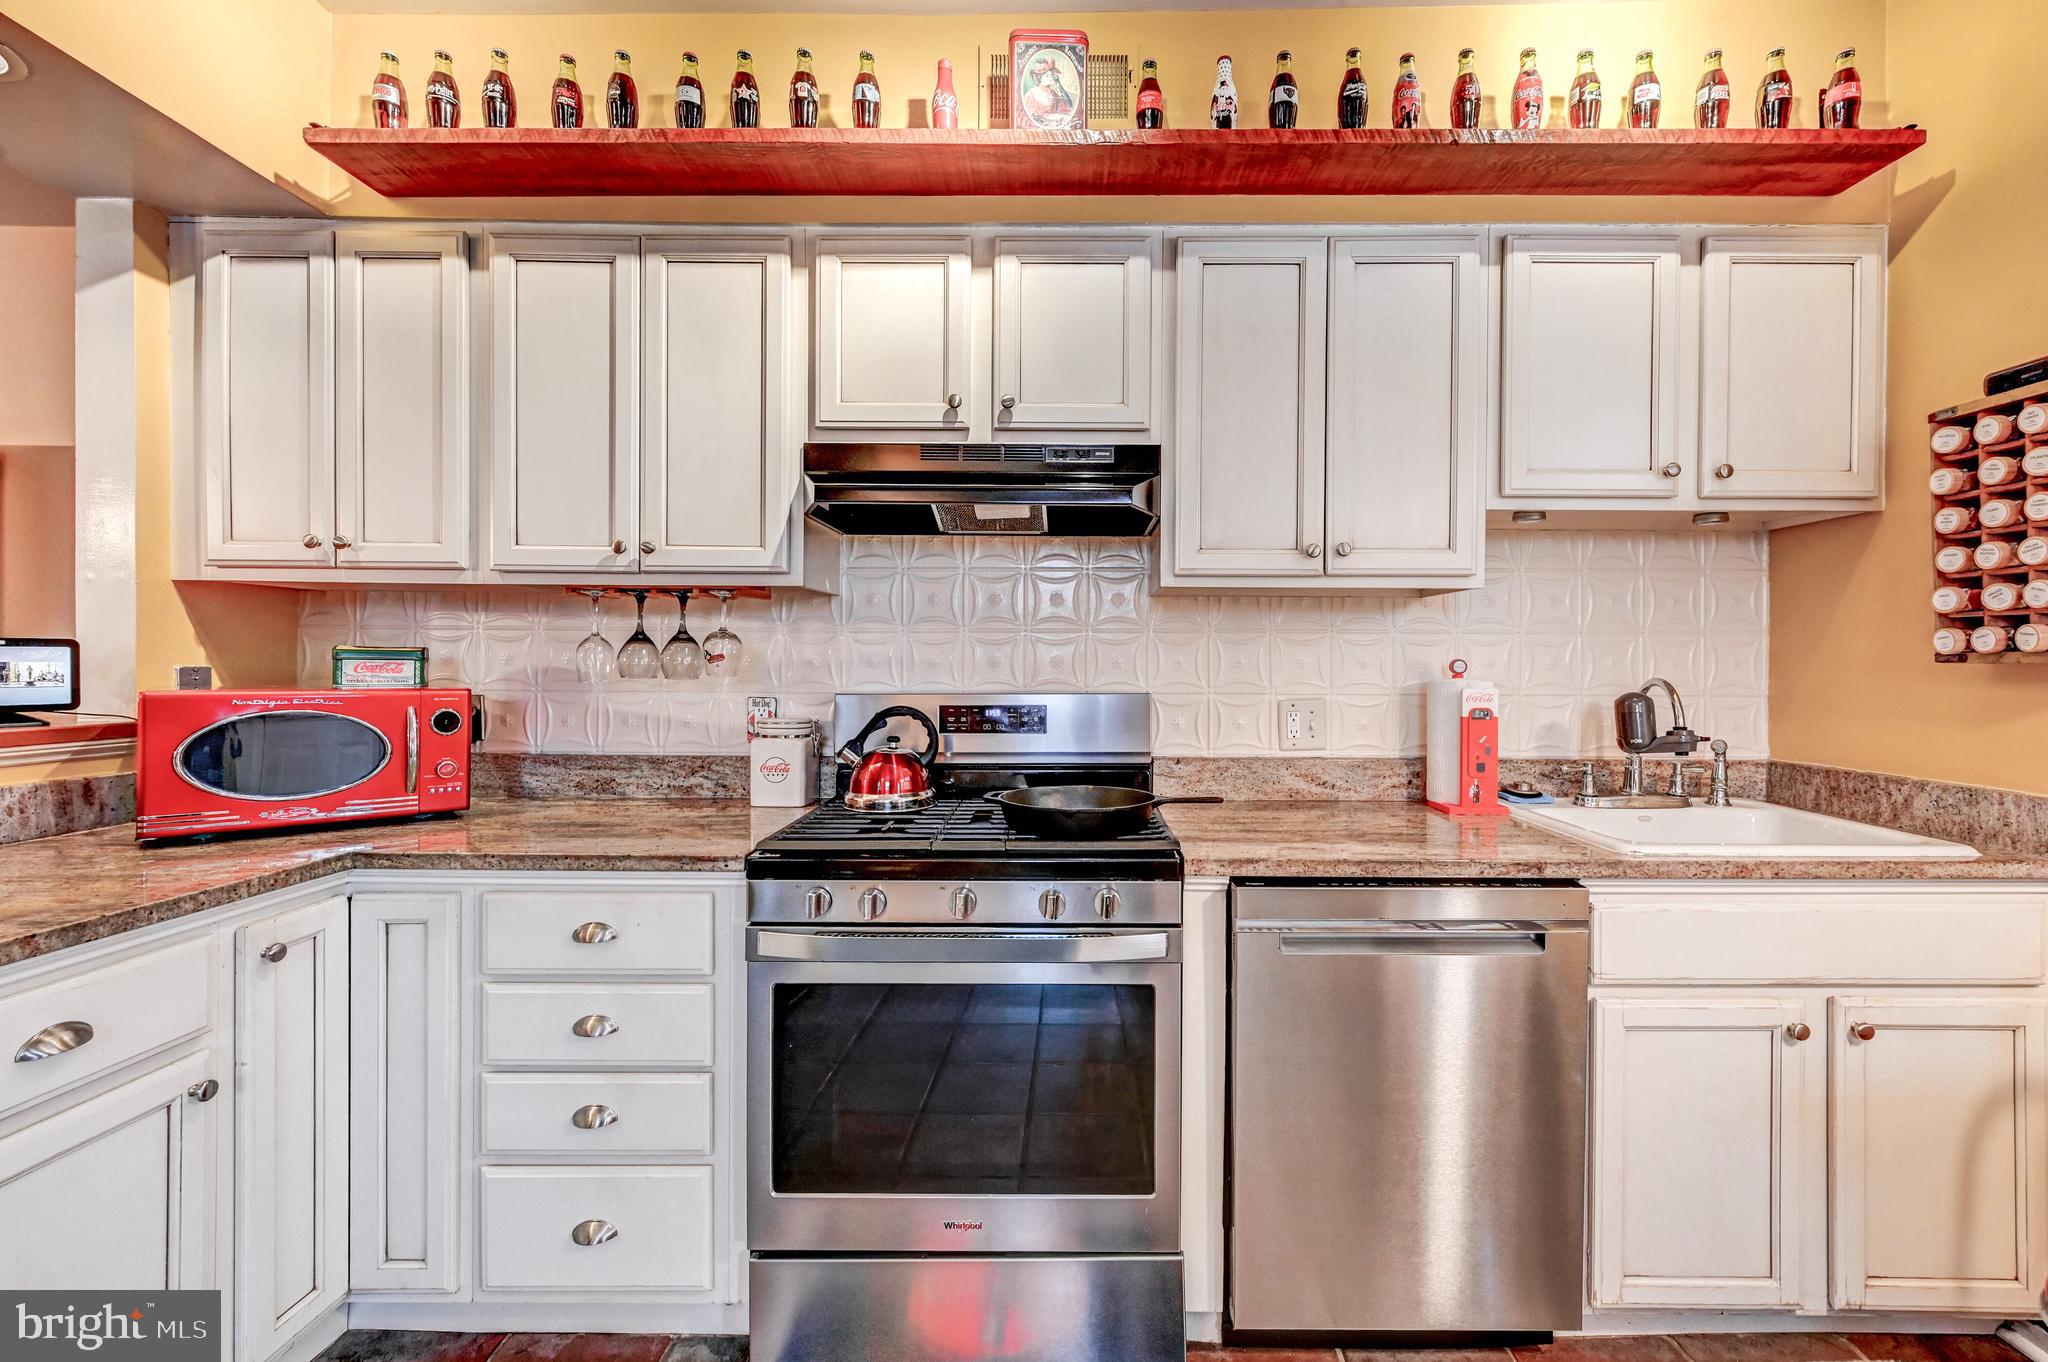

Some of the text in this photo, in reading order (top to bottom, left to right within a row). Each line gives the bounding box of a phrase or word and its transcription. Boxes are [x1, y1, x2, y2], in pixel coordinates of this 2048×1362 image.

[353, 661, 407, 674] Coca-Cola
[231, 699, 289, 708] Nostalgia
[1465, 692, 1495, 704] Coca-Cola
[759, 762, 791, 773] Coca-Cola
[943, 1221, 982, 1231] Whirlpool
